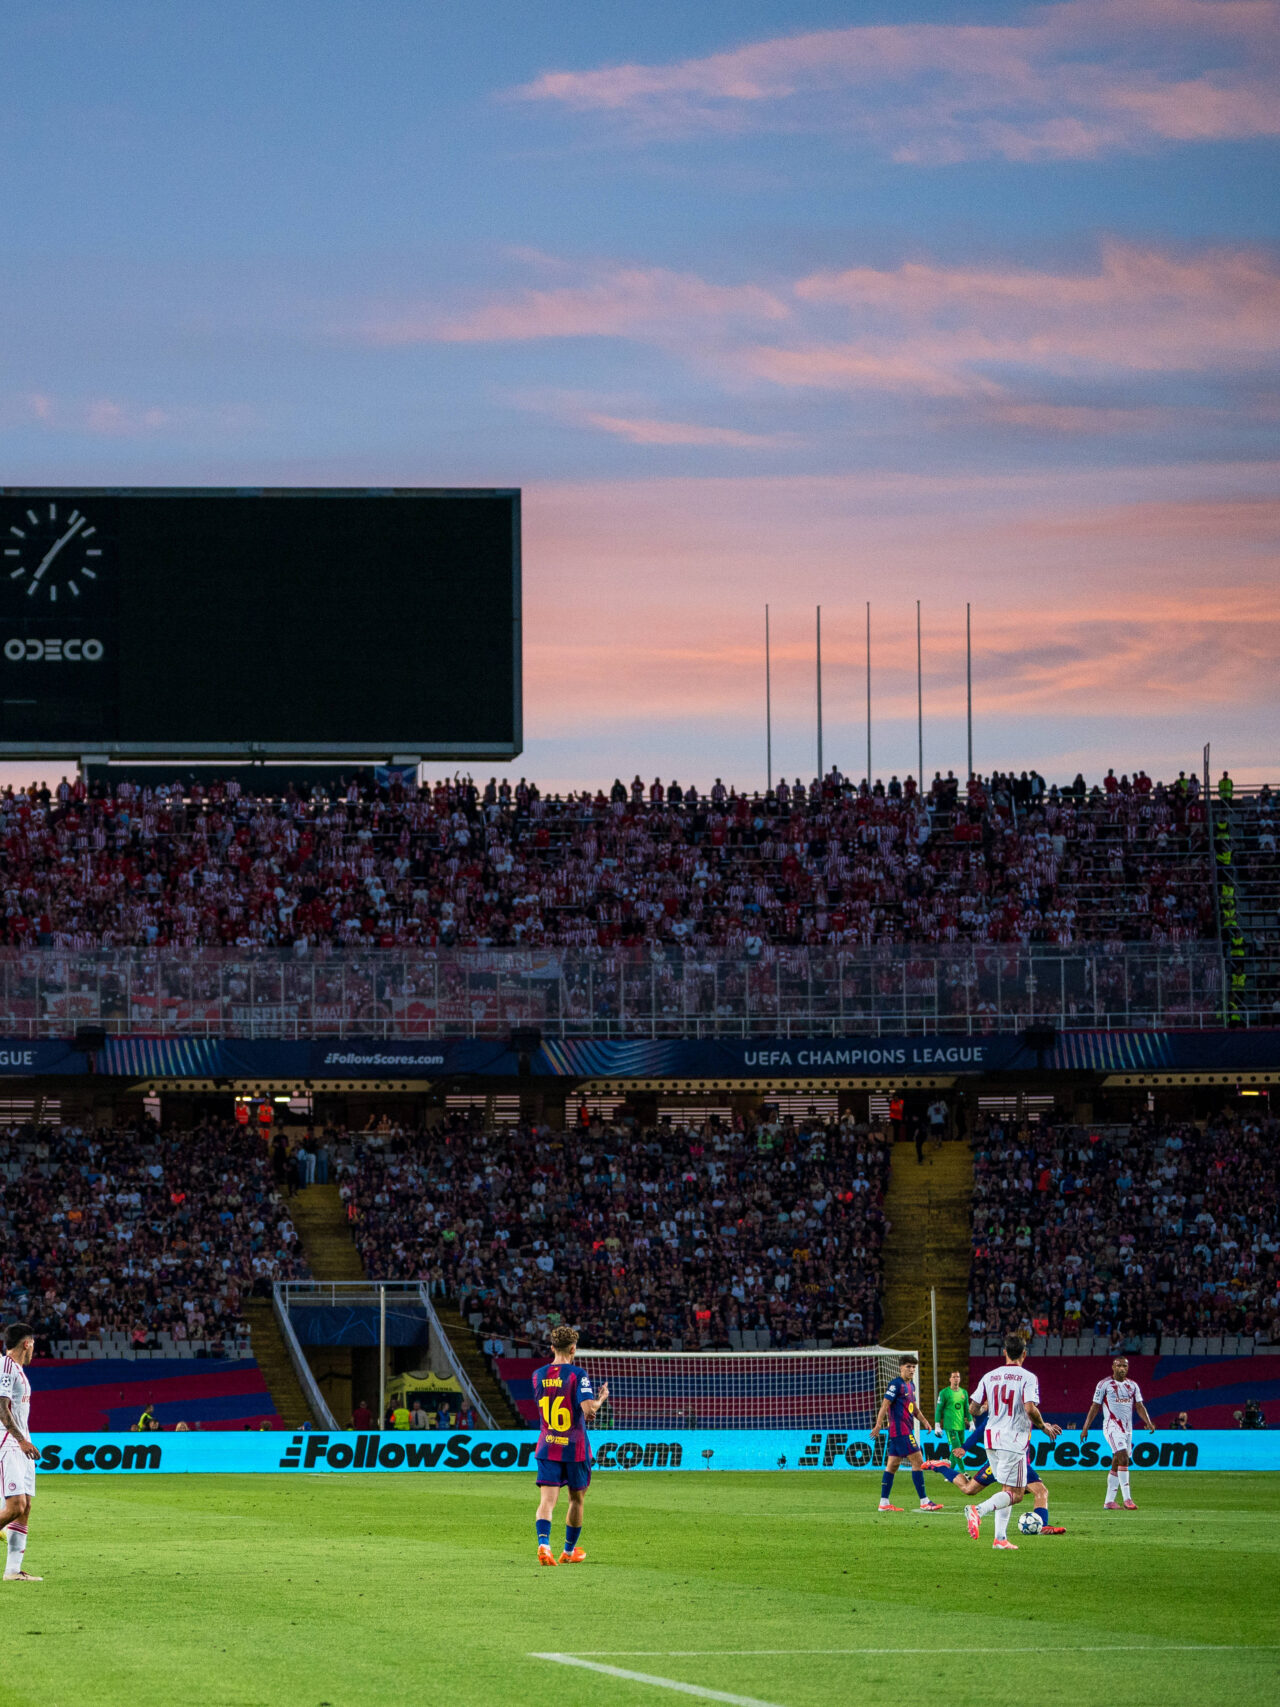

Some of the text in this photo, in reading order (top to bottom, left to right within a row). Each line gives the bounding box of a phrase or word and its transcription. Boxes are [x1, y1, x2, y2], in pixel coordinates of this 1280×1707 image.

[4, 638, 104, 661] ODECO
[330, 1053, 444, 1065] FollowScores.com
[744, 1046, 983, 1066] UEFA CHAMPIONS LEAGUE
[993, 1383, 1016, 1417] 14
[538, 1395, 572, 1433] 16
[909, 1434, 916, 1444] 5
